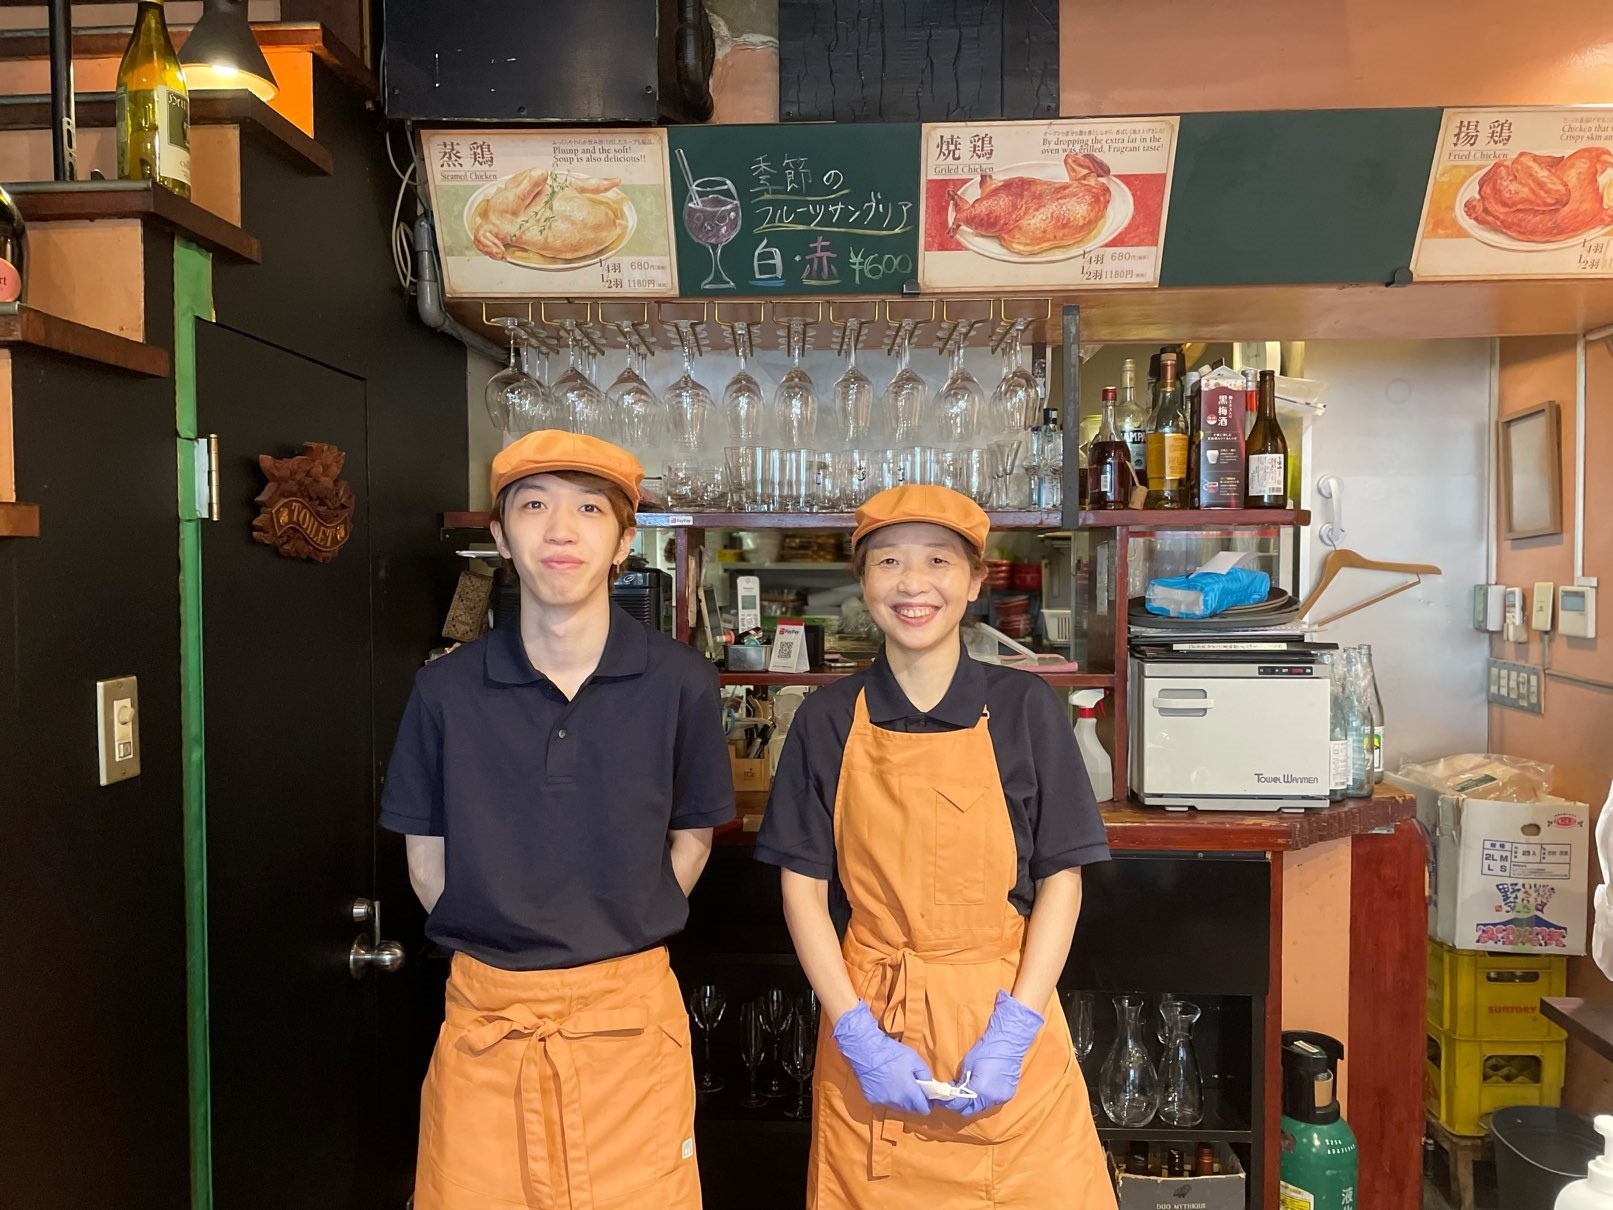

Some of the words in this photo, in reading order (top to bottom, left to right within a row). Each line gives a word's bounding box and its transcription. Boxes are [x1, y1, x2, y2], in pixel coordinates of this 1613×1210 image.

[1562, 123, 1592, 132] Chicken
[1594, 124, 1609, 132] that
[1042, 138, 1054, 146] By
[1054, 137, 1089, 147] dropping
[1091, 136, 1104, 144] the
[1127, 135, 1137, 143] fat
[1560, 132, 1585, 143] Crispy
[1586, 132, 1602, 140] skin
[553, 146, 579, 156] Plump
[581, 146, 597, 154] and
[598, 146, 612, 154] the
[613, 146, 632, 154] soft!
[1108, 144, 1141, 154] Fragrant
[1142, 143, 1164, 151] taste!
[553, 154, 575, 164] Soup
[585, 154, 602, 162] also
[603, 154, 647, 162] delicious!!
[1448, 151, 1471, 160] Fried
[1473, 151, 1508, 160] Chicken
[934, 165, 959, 174] Griled
[961, 165, 994, 173] Chicken
[440, 171, 468, 180] Steamed
[469, 171, 498, 180] Chicken
[755, 192, 912, 232] フルーツサングリア
[849, 247, 912, 284] ¥600
[291, 502, 336, 547] TOILET
[1484, 853, 1498, 862] 2L
[1499, 854, 1509, 863] M
[1487, 863, 1494, 872] L
[1499, 864, 1508, 873] S
